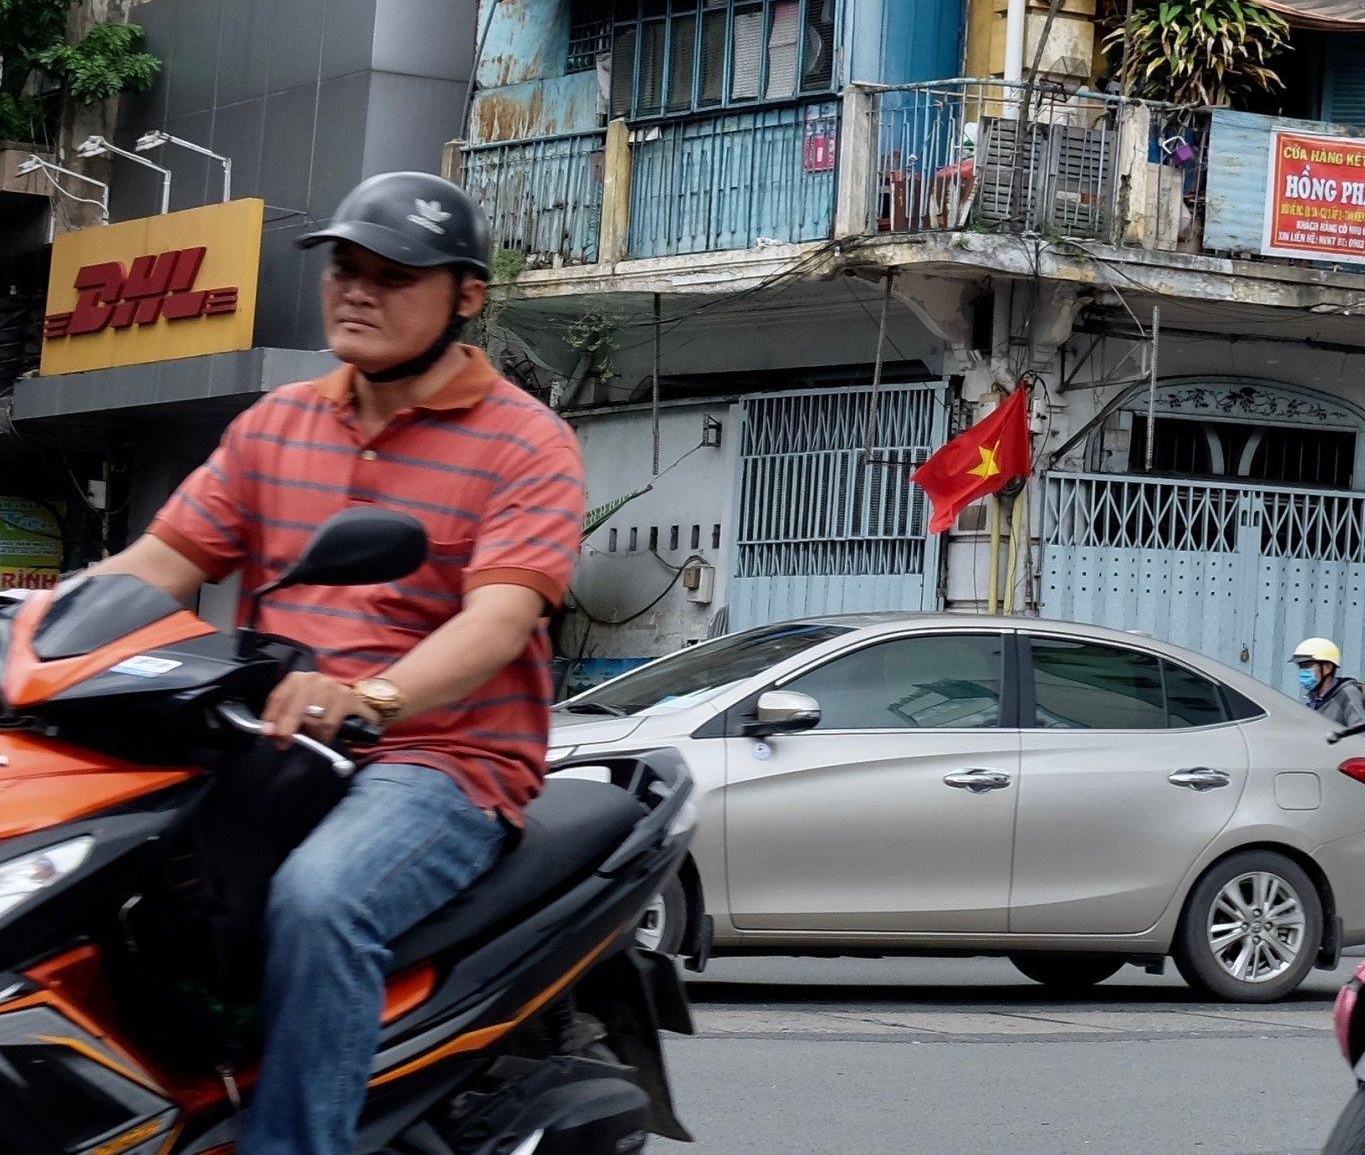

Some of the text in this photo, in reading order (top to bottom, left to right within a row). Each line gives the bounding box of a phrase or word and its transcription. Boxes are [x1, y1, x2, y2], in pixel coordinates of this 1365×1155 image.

[1283, 144, 1308, 161] CỬA
[1311, 148, 1343, 164] HÀNG
[1285, 165, 1337, 203] HỒNG
[66, 246, 208, 336] DHL
